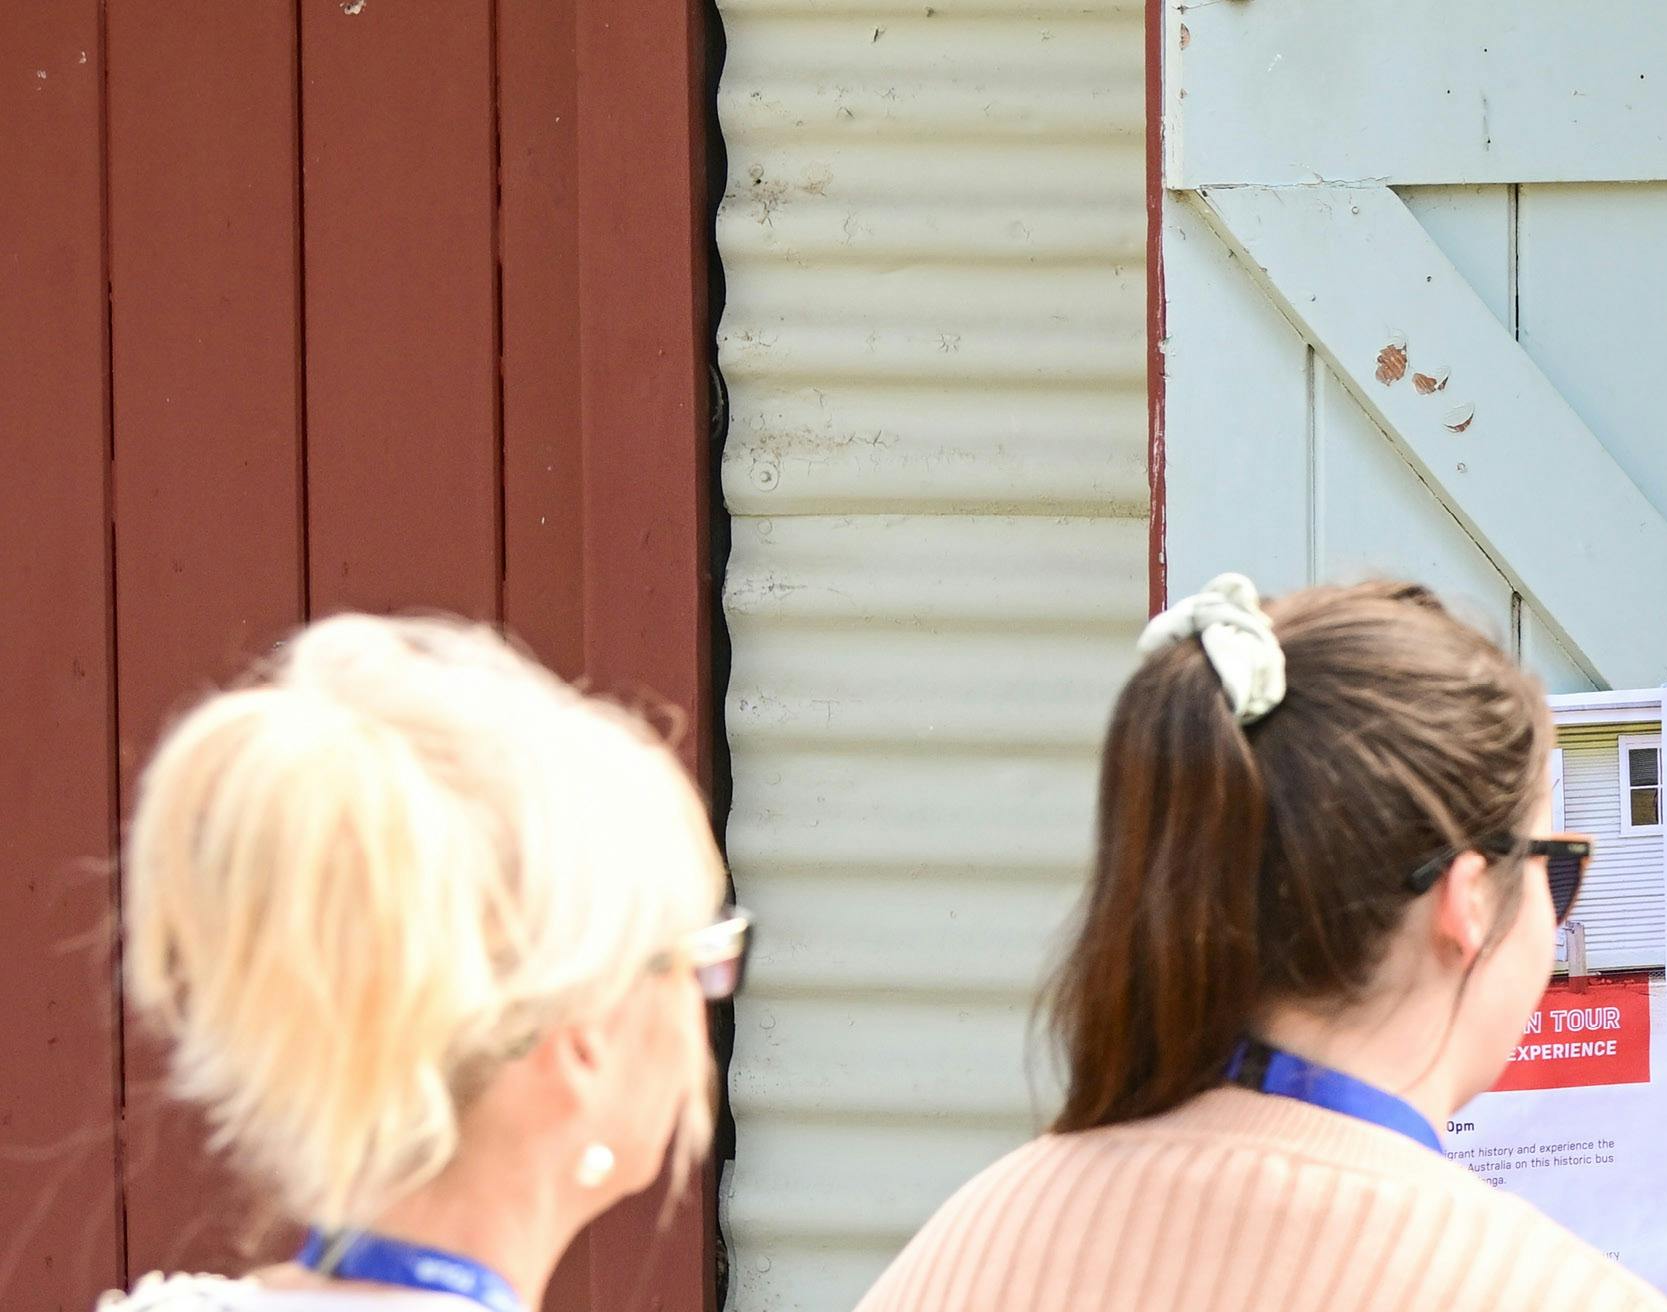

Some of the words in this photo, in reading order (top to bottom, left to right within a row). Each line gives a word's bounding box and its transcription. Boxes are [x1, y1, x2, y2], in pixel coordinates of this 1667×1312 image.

[1550, 1007, 1620, 1033] TOUR
[1478, 1144, 1514, 1157] history
[1516, 1144, 1536, 1155] and
[1539, 1141, 1594, 1155] experience
[1598, 1138, 1615, 1149] the
[1468, 1159, 1512, 1172] Australia
[1515, 1161, 1528, 1169] on
[1531, 1158, 1550, 1168] this
[1553, 1154, 1592, 1166] historic
[1595, 1153, 1614, 1164] bus
